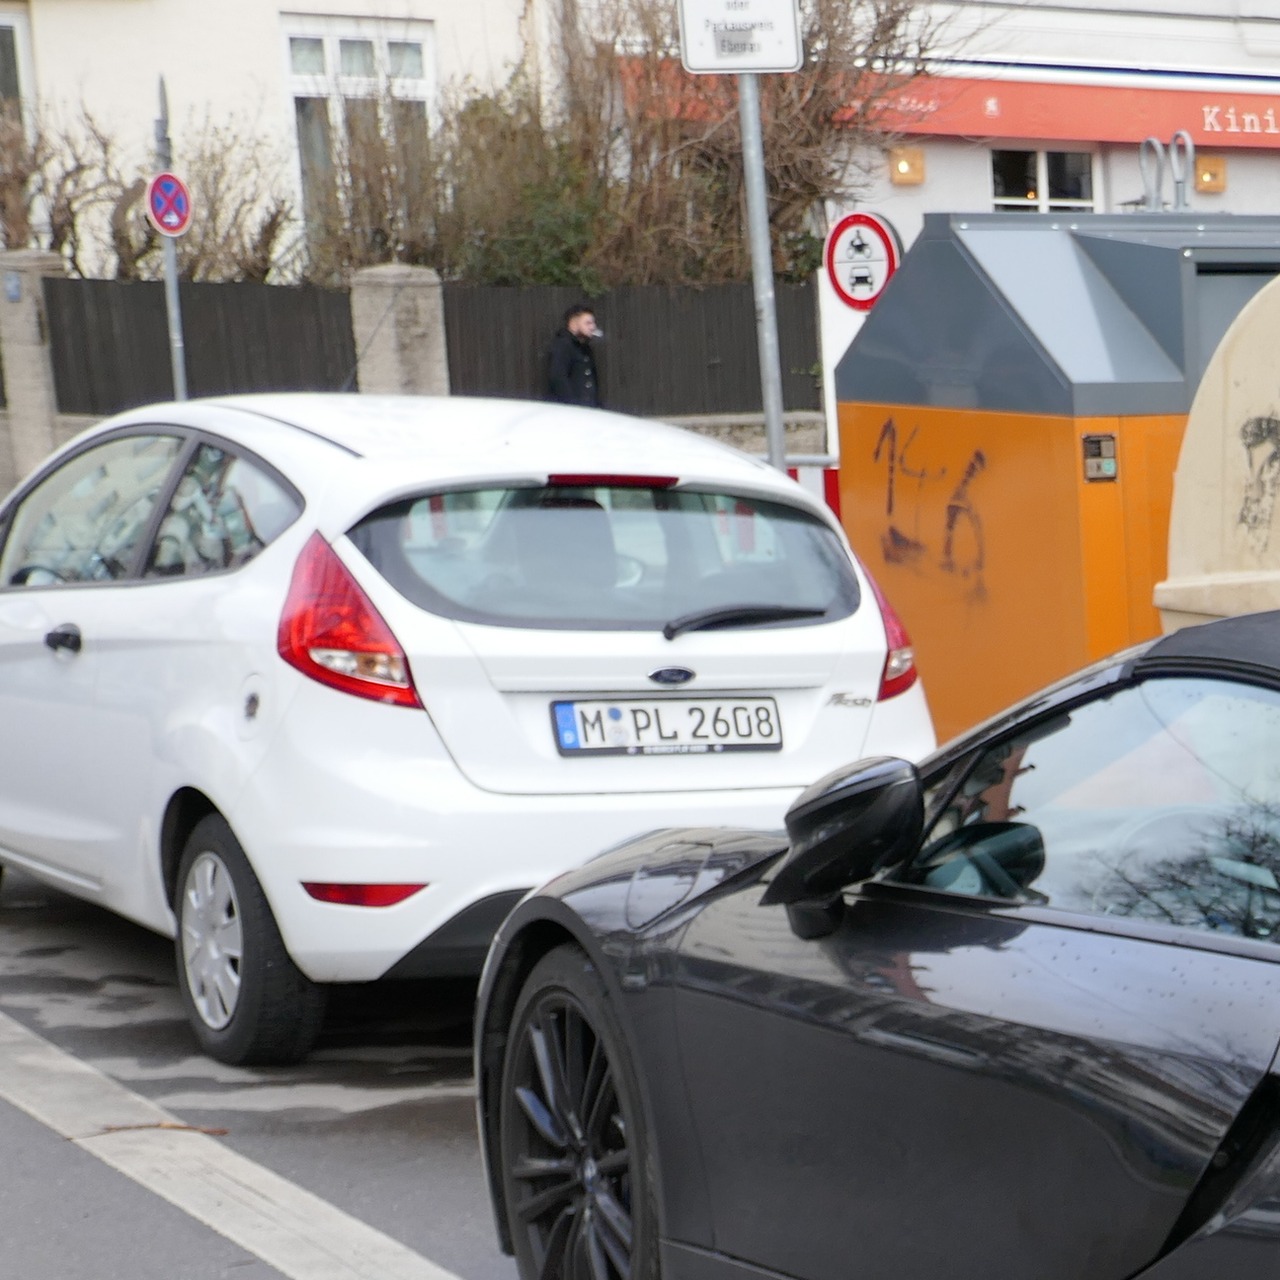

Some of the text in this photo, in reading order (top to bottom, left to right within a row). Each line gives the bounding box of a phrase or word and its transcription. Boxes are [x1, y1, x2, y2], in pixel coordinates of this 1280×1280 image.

[579, 706, 775, 743] M PL 2608
